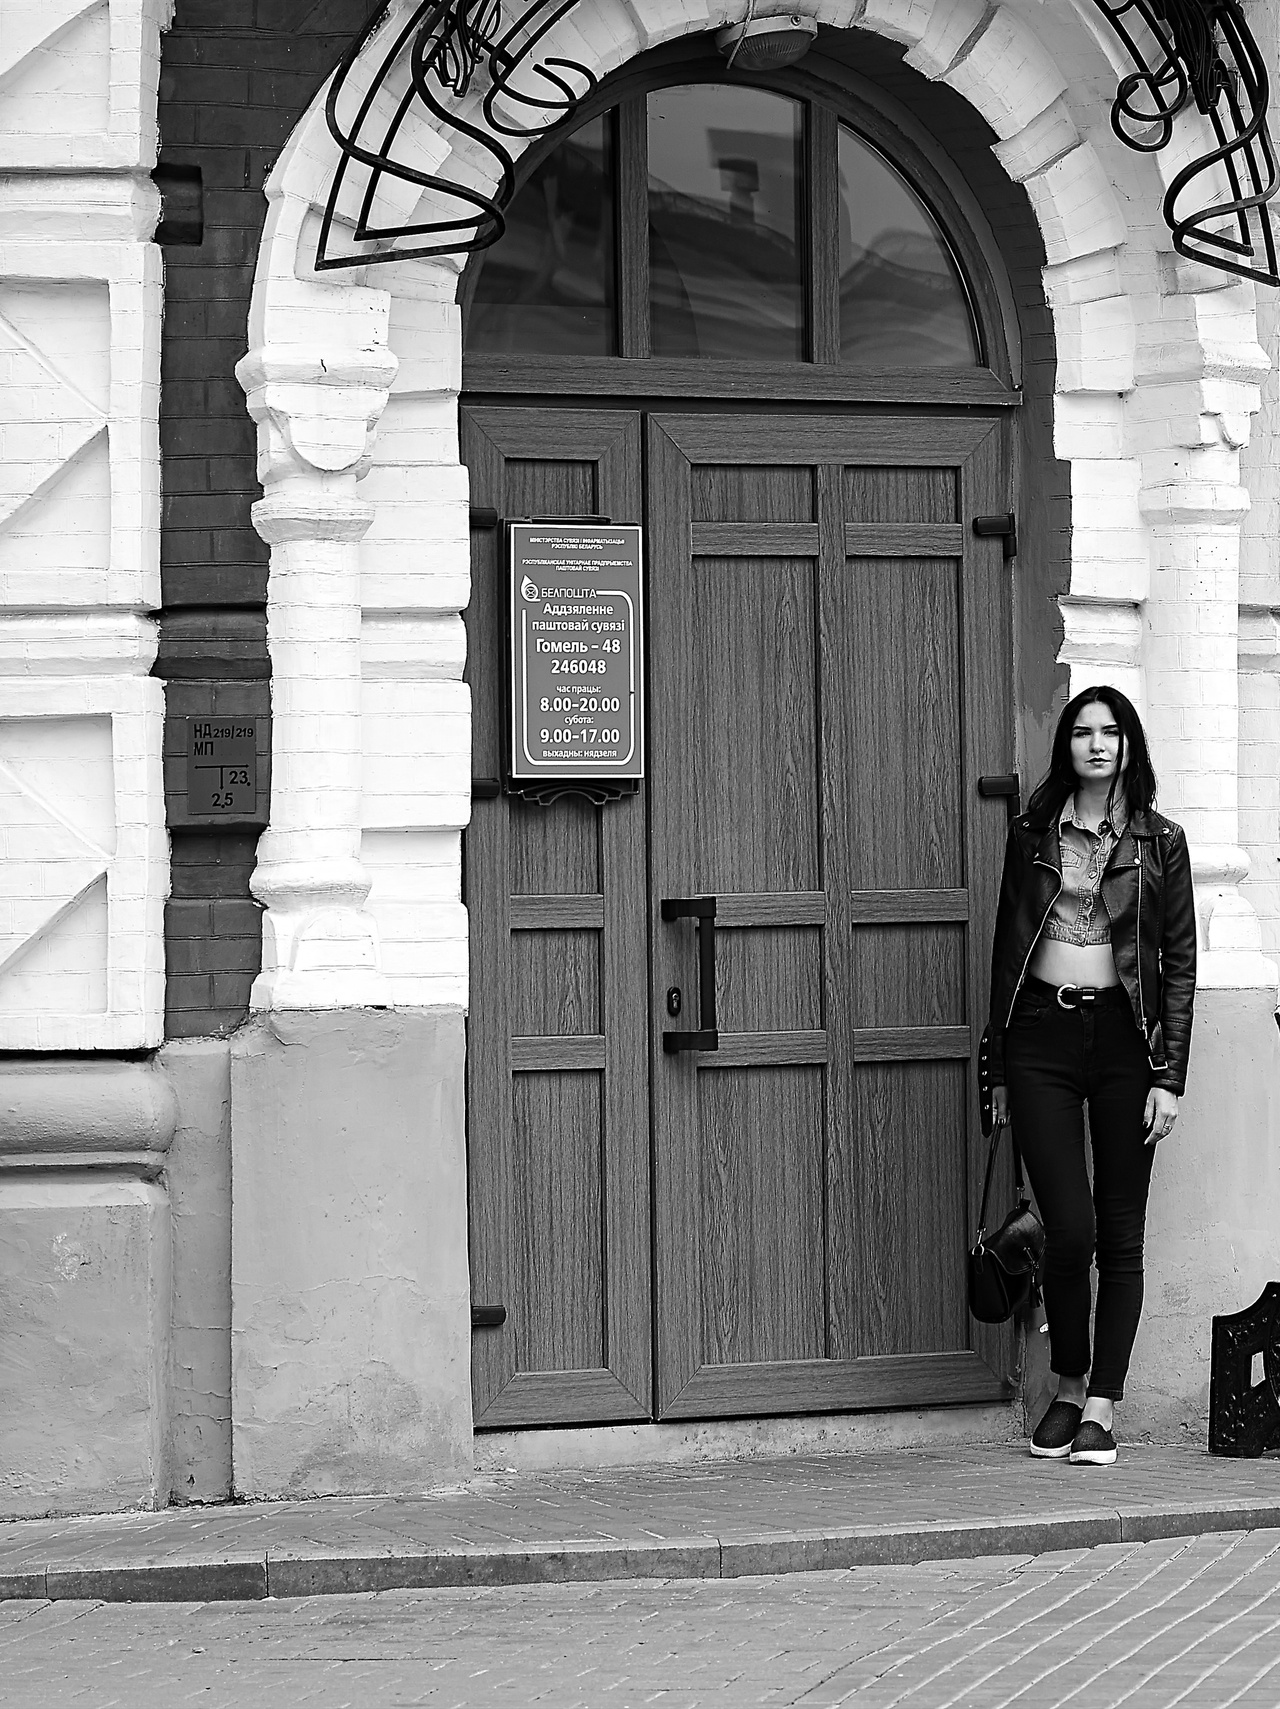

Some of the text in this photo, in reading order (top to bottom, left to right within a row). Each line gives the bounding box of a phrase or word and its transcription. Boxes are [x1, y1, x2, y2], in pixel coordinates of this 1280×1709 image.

[541, 588, 597, 598] БЕЛПОШТА
[543, 602, 614, 616] Аддзяленне
[532, 619, 625, 633] паштовай сувязі
[536, 638, 589, 653] Гомель
[602, 638, 621, 653] 48
[551, 659, 607, 674] 246048
[556, 685, 601, 694] час працы:
[564, 714, 594, 725] субота:
[213, 725, 254, 739] 219/219
[193, 741, 214, 756] МП
[584, 750, 617, 758] нядзеля
